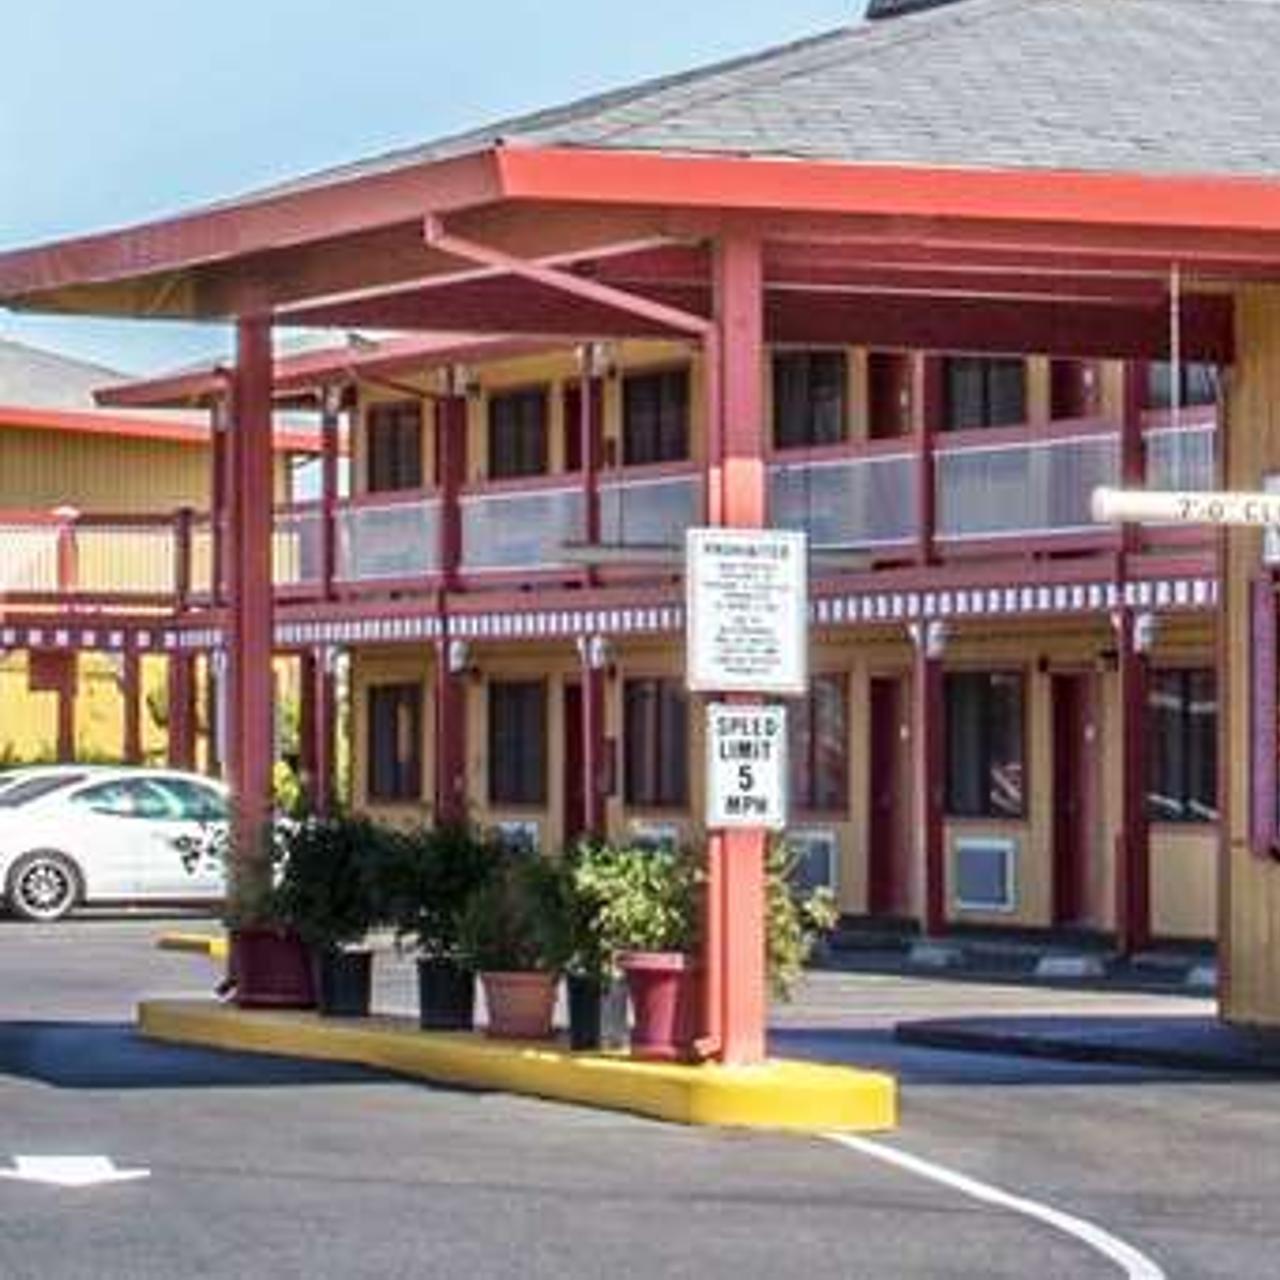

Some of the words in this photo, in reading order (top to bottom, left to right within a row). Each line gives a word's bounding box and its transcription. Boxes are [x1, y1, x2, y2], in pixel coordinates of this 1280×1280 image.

[717, 717, 777, 736] SPEED
[720, 742, 771, 760] LIMIT
[738, 765, 754, 791] 5
[725, 795, 768, 814] MPH
